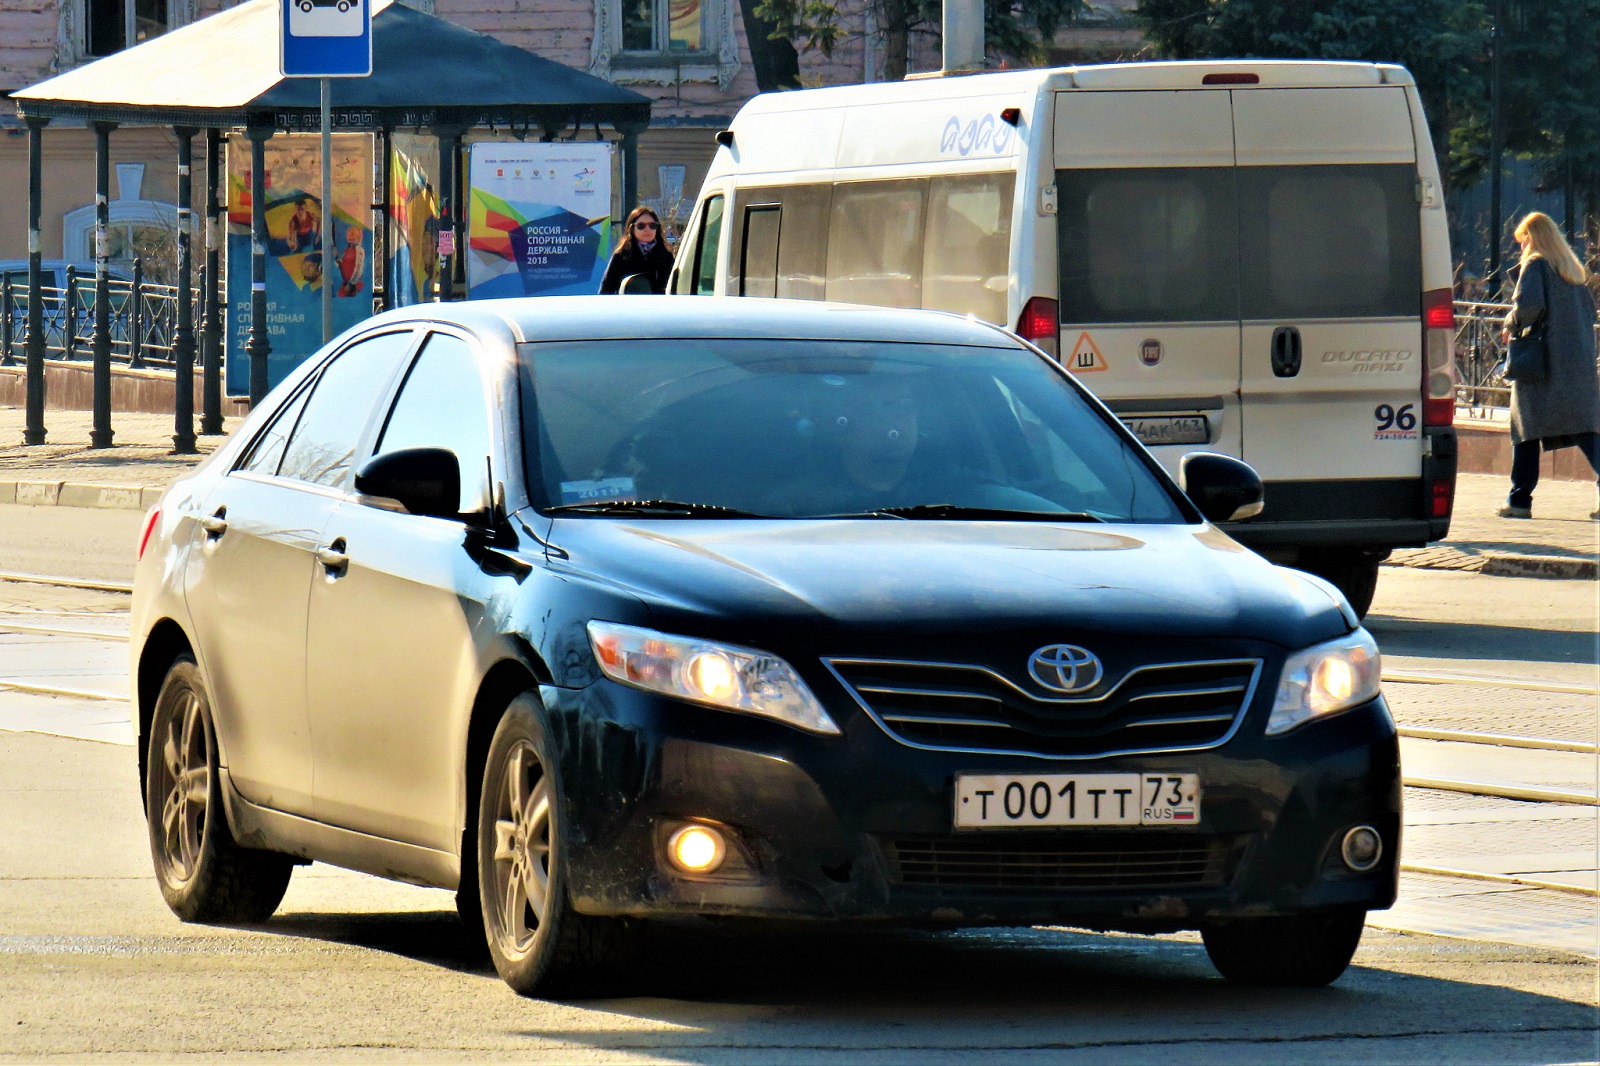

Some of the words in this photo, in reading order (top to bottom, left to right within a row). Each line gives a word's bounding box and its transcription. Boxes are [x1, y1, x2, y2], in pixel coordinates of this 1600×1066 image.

[527, 226, 561, 235] РОССИЯ
[527, 236, 585, 245] СПОРТИВНАЯ
[527, 246, 569, 255] ДЕРЖАВА
[527, 256, 548, 265] 2018
[237, 302, 277, 312] РОИЯ
[237, 313, 305, 323] СПТИВНАЯ
[236, 325, 286, 336] ДЕАВА
[1143, 346, 1160, 360] FIAT
[1321, 350, 1412, 362] DUCATO
[1353, 362, 1406, 373] MAXI
[1374, 403, 1416, 431] 96
[1146, 777, 1183, 807] 73
[1143, 808, 1172, 819] RUS
